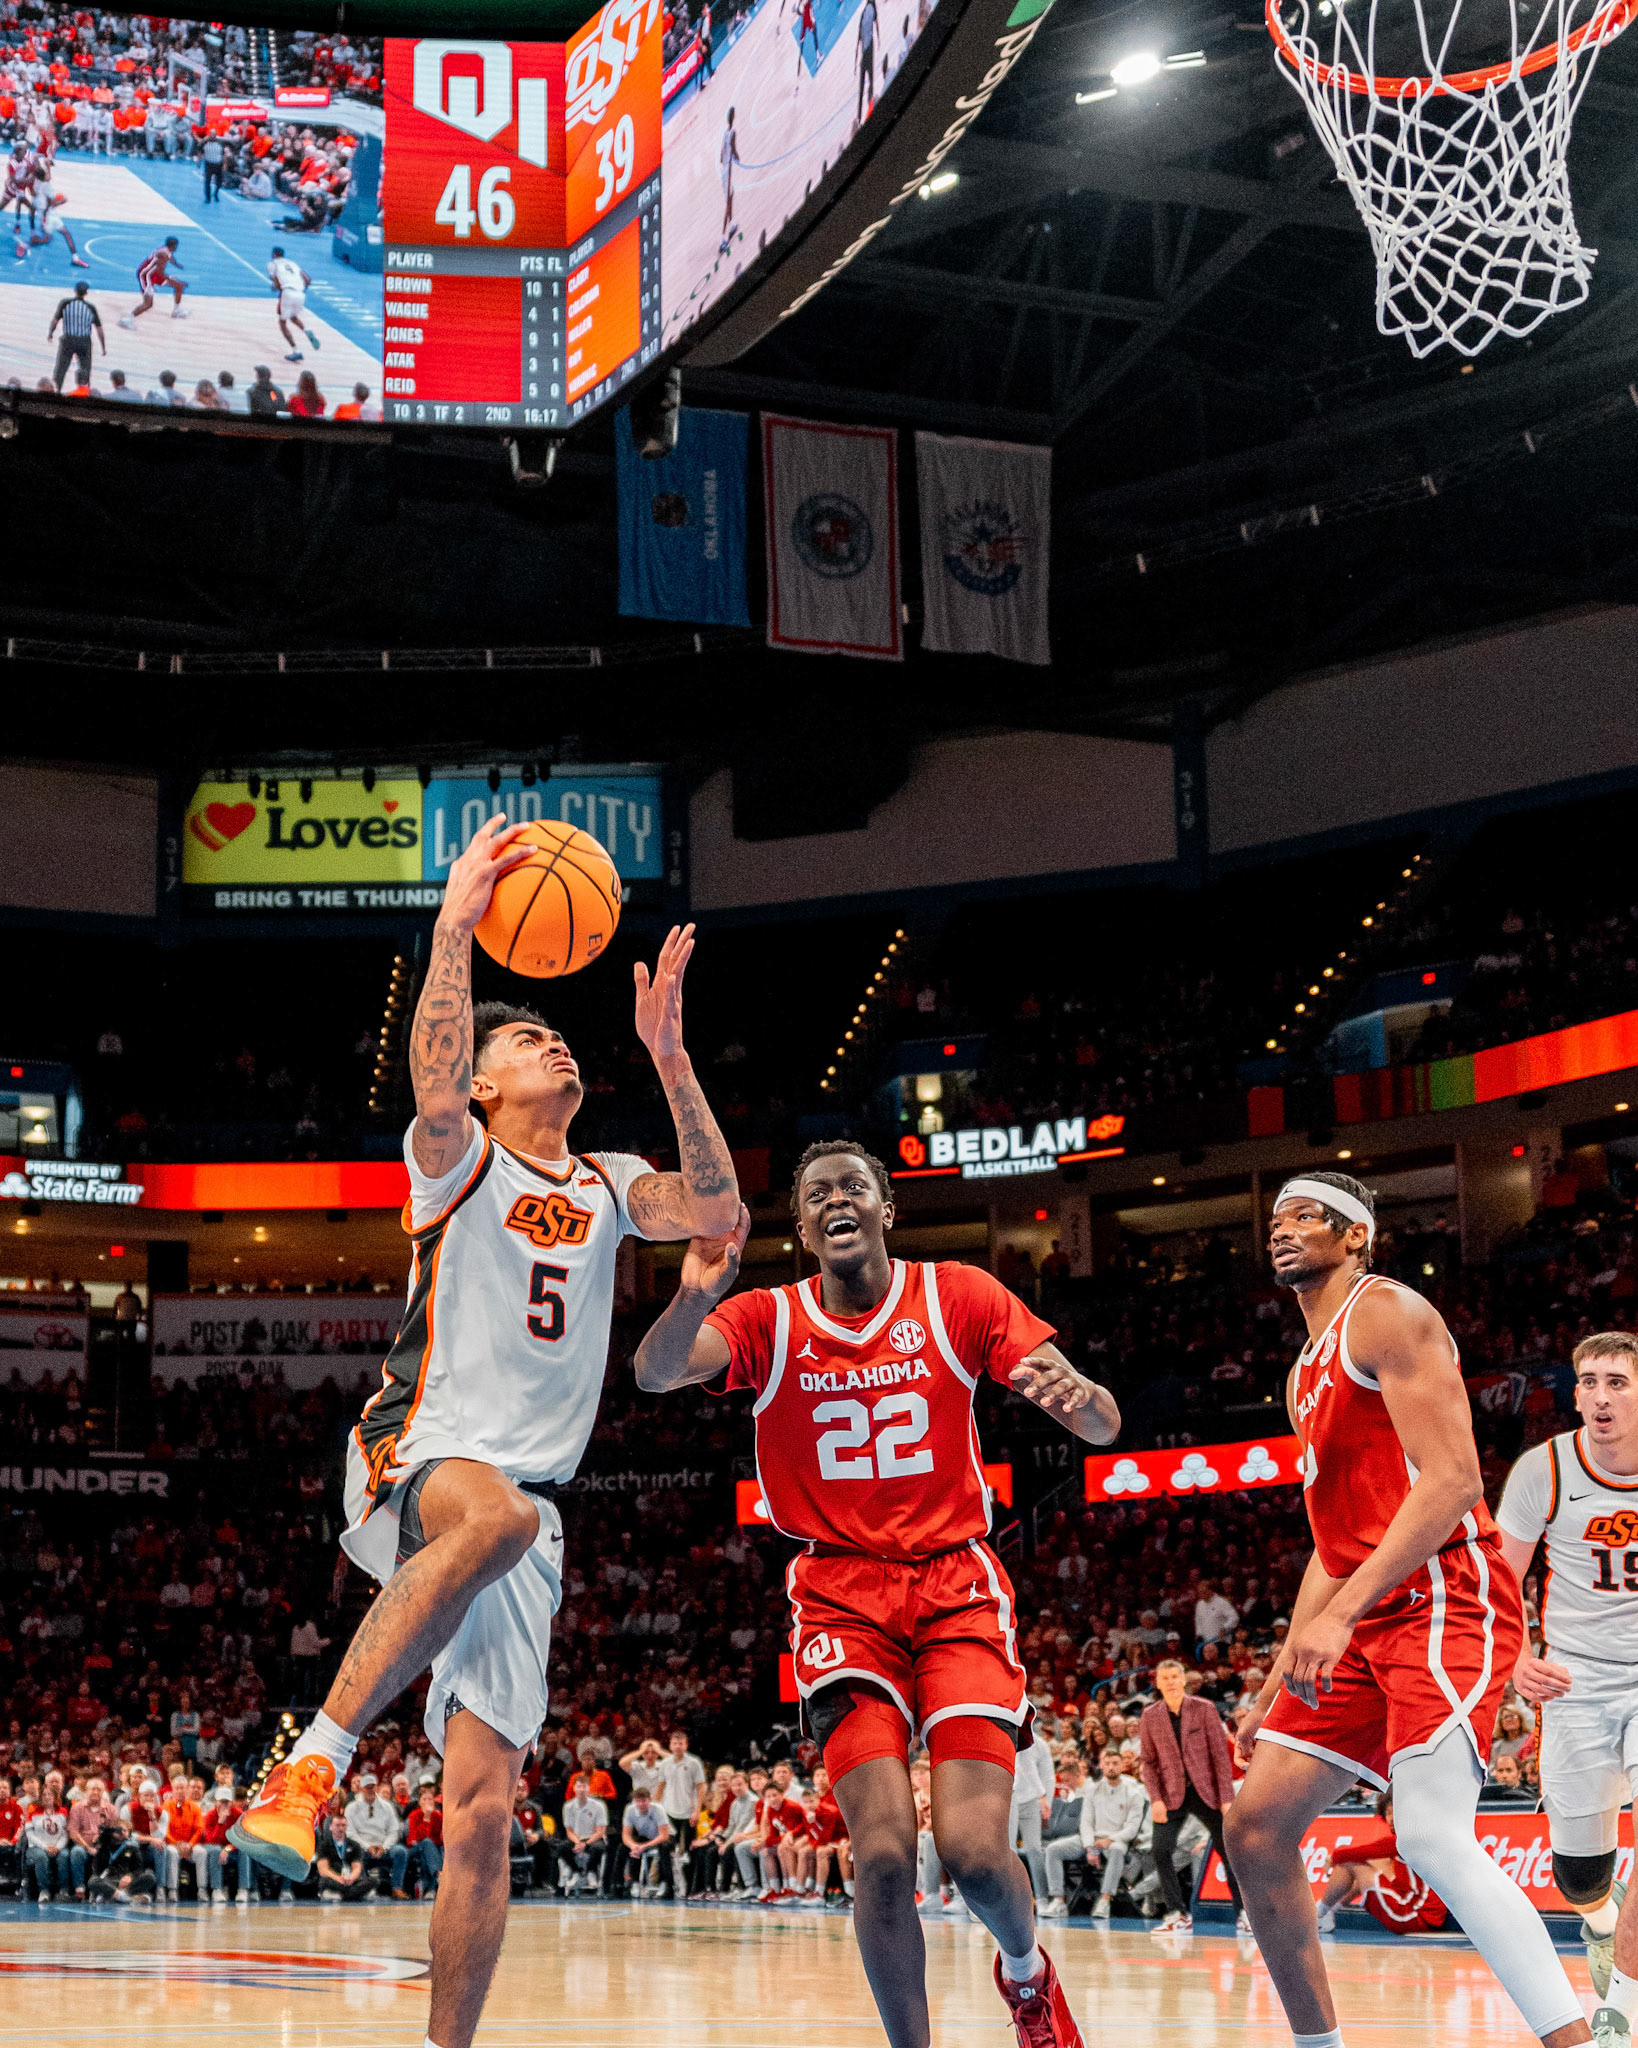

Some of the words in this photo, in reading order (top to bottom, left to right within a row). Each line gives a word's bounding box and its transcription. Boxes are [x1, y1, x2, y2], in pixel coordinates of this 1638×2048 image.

[595, 114, 635, 212] 39
[435, 164, 515, 239] 46
[387, 251, 434, 268] PLAYER
[520, 256, 544, 272] PTS
[547, 257, 563, 272] FL
[385, 276, 432, 294] BROWN
[525, 281, 542, 298] 10
[552, 281, 559, 298] 1
[385, 301, 429, 319] WAGUE
[528, 307, 538, 322] 4
[552, 307, 559, 322] 1
[385, 327, 424, 344] JONES
[528, 332, 538, 347] 9
[552, 332, 559, 347] 1
[385, 352, 415, 369] ATAK
[528, 357, 538, 372] 3
[552, 357, 559, 372] 1
[385, 377, 416, 394] REID
[528, 382, 538, 398] 5
[550, 382, 560, 398] 0
[394, 403, 410, 420] TO
[416, 404, 425, 419] 3
[434, 405, 449, 421] TF
[455, 406, 464, 422] 2
[485, 406, 512, 423] 2ND
[524, 408, 558, 424] 16:17
[215, 891, 291, 907] BRING
[298, 891, 348, 907] THE
[354, 889, 444, 906] THUND
[929, 1117, 1087, 1167] BEDLAM
[25, 1160, 99, 1178] PRESENTED
[100, 1164, 121, 1180] BY
[963, 1156, 1057, 1179] BASKETBALL
[504, 1192, 594, 1249] OSU
[527, 1261, 569, 1343] 5
[191, 1320, 239, 1345] POST
[272, 1320, 310, 1345] OAK
[320, 1320, 389, 1343] PARTY
[890, 1320, 924, 1352] SEC
[799, 1358, 931, 1392] OKLAHOMA
[812, 1392, 934, 1480] 22
[1032, 1443, 1069, 1468] 112
[562, 1468, 715, 1491] okcthunder
[1583, 1510, 1638, 1549] OS
[803, 1632, 846, 1670] OU
